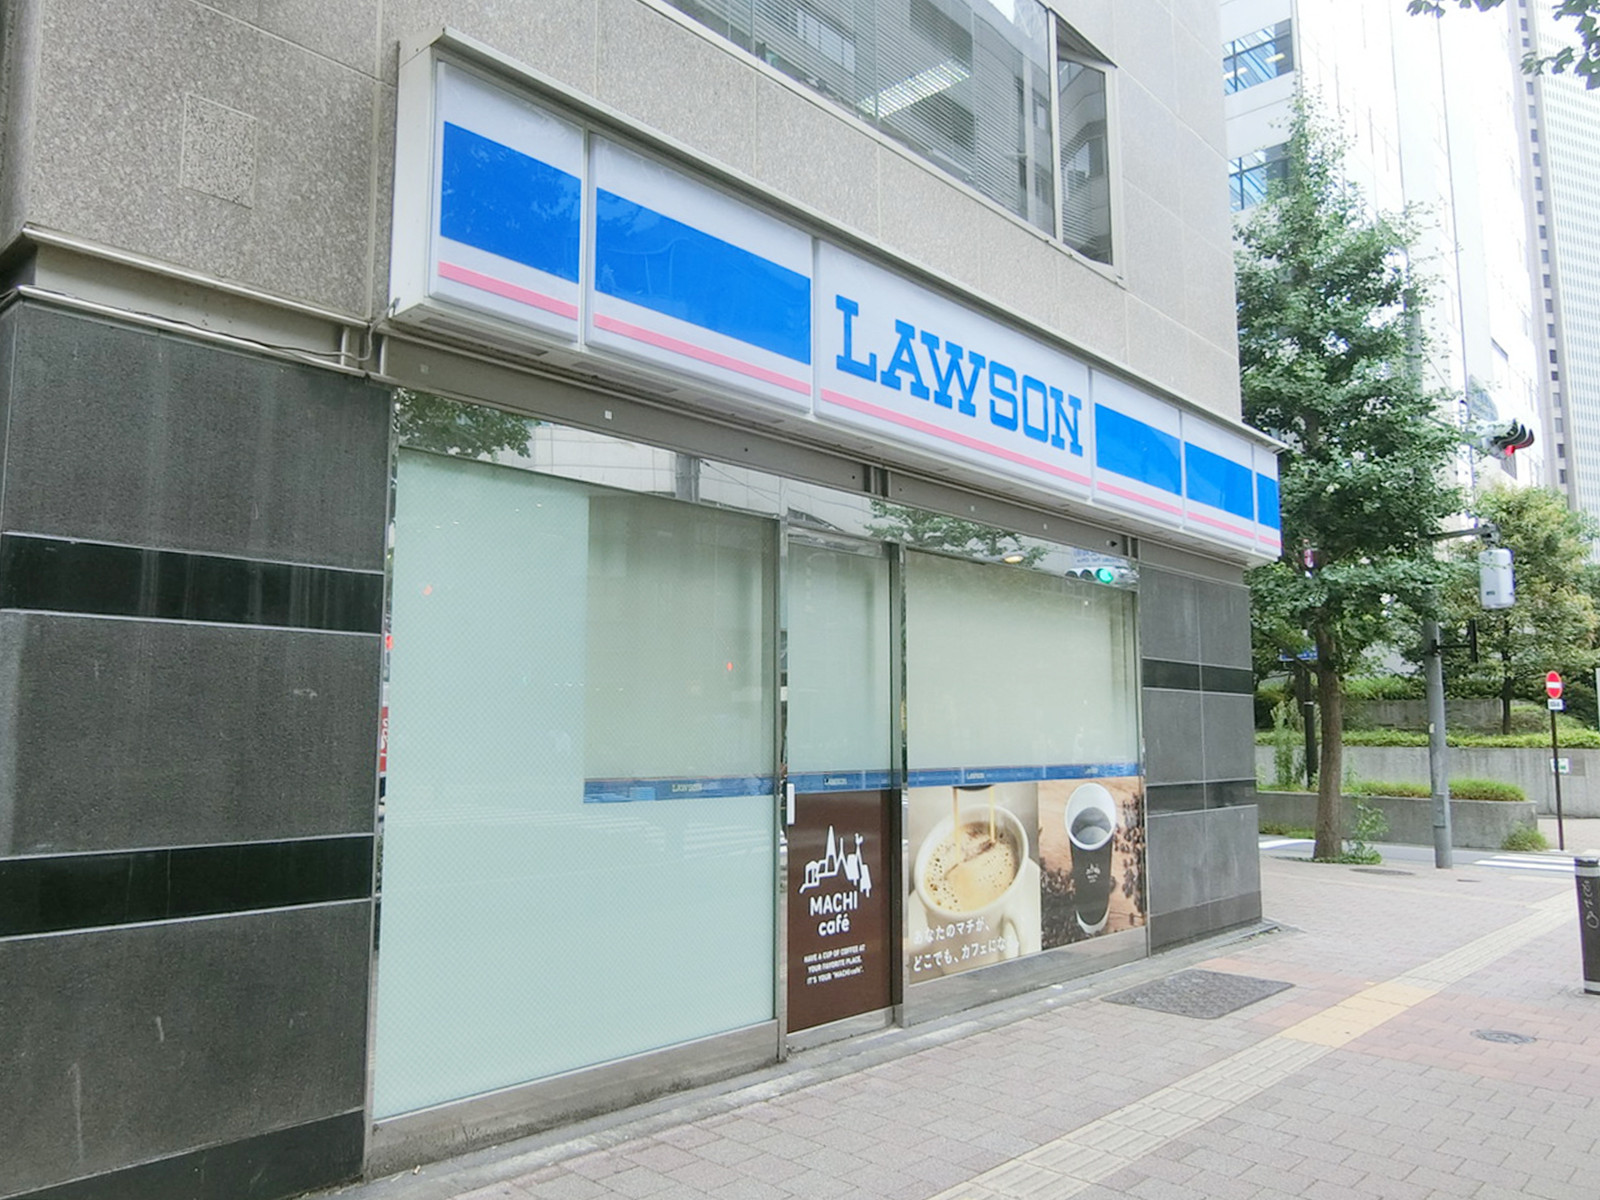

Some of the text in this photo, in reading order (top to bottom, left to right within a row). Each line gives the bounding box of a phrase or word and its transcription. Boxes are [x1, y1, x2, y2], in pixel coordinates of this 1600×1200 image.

[836, 294, 1083, 457] LAWSON
[810, 890, 858, 916] MACHI
[818, 913, 850, 936] café
